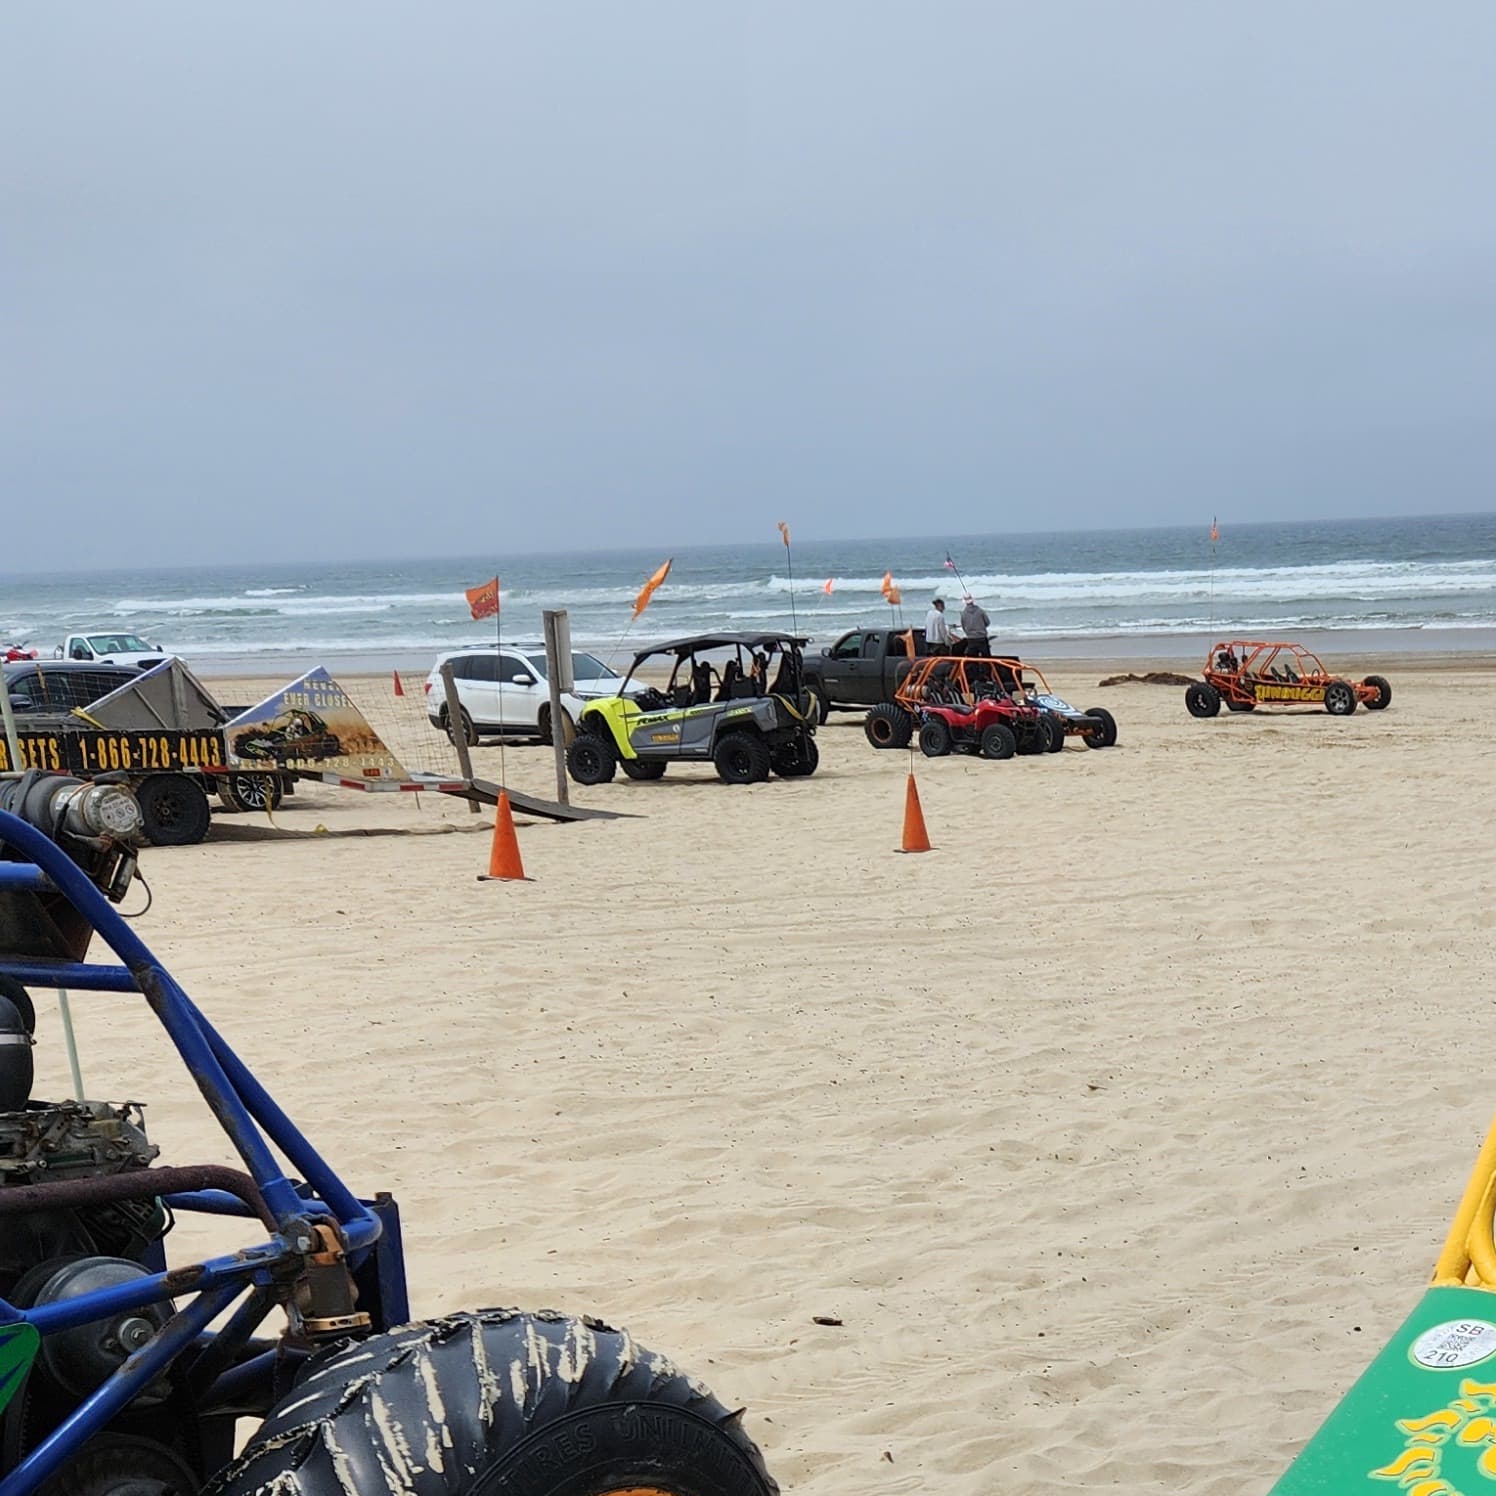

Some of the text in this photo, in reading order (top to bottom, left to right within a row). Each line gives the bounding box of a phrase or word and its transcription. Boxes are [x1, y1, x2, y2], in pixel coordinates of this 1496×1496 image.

[17, 737, 60, 770] SETS
[79, 736, 220, 770] 1-866-728-4443
[1456, 1323, 1485, 1336] SB
[1423, 1350, 1459, 1363] 210
[498, 1422, 599, 1487] TIRES
